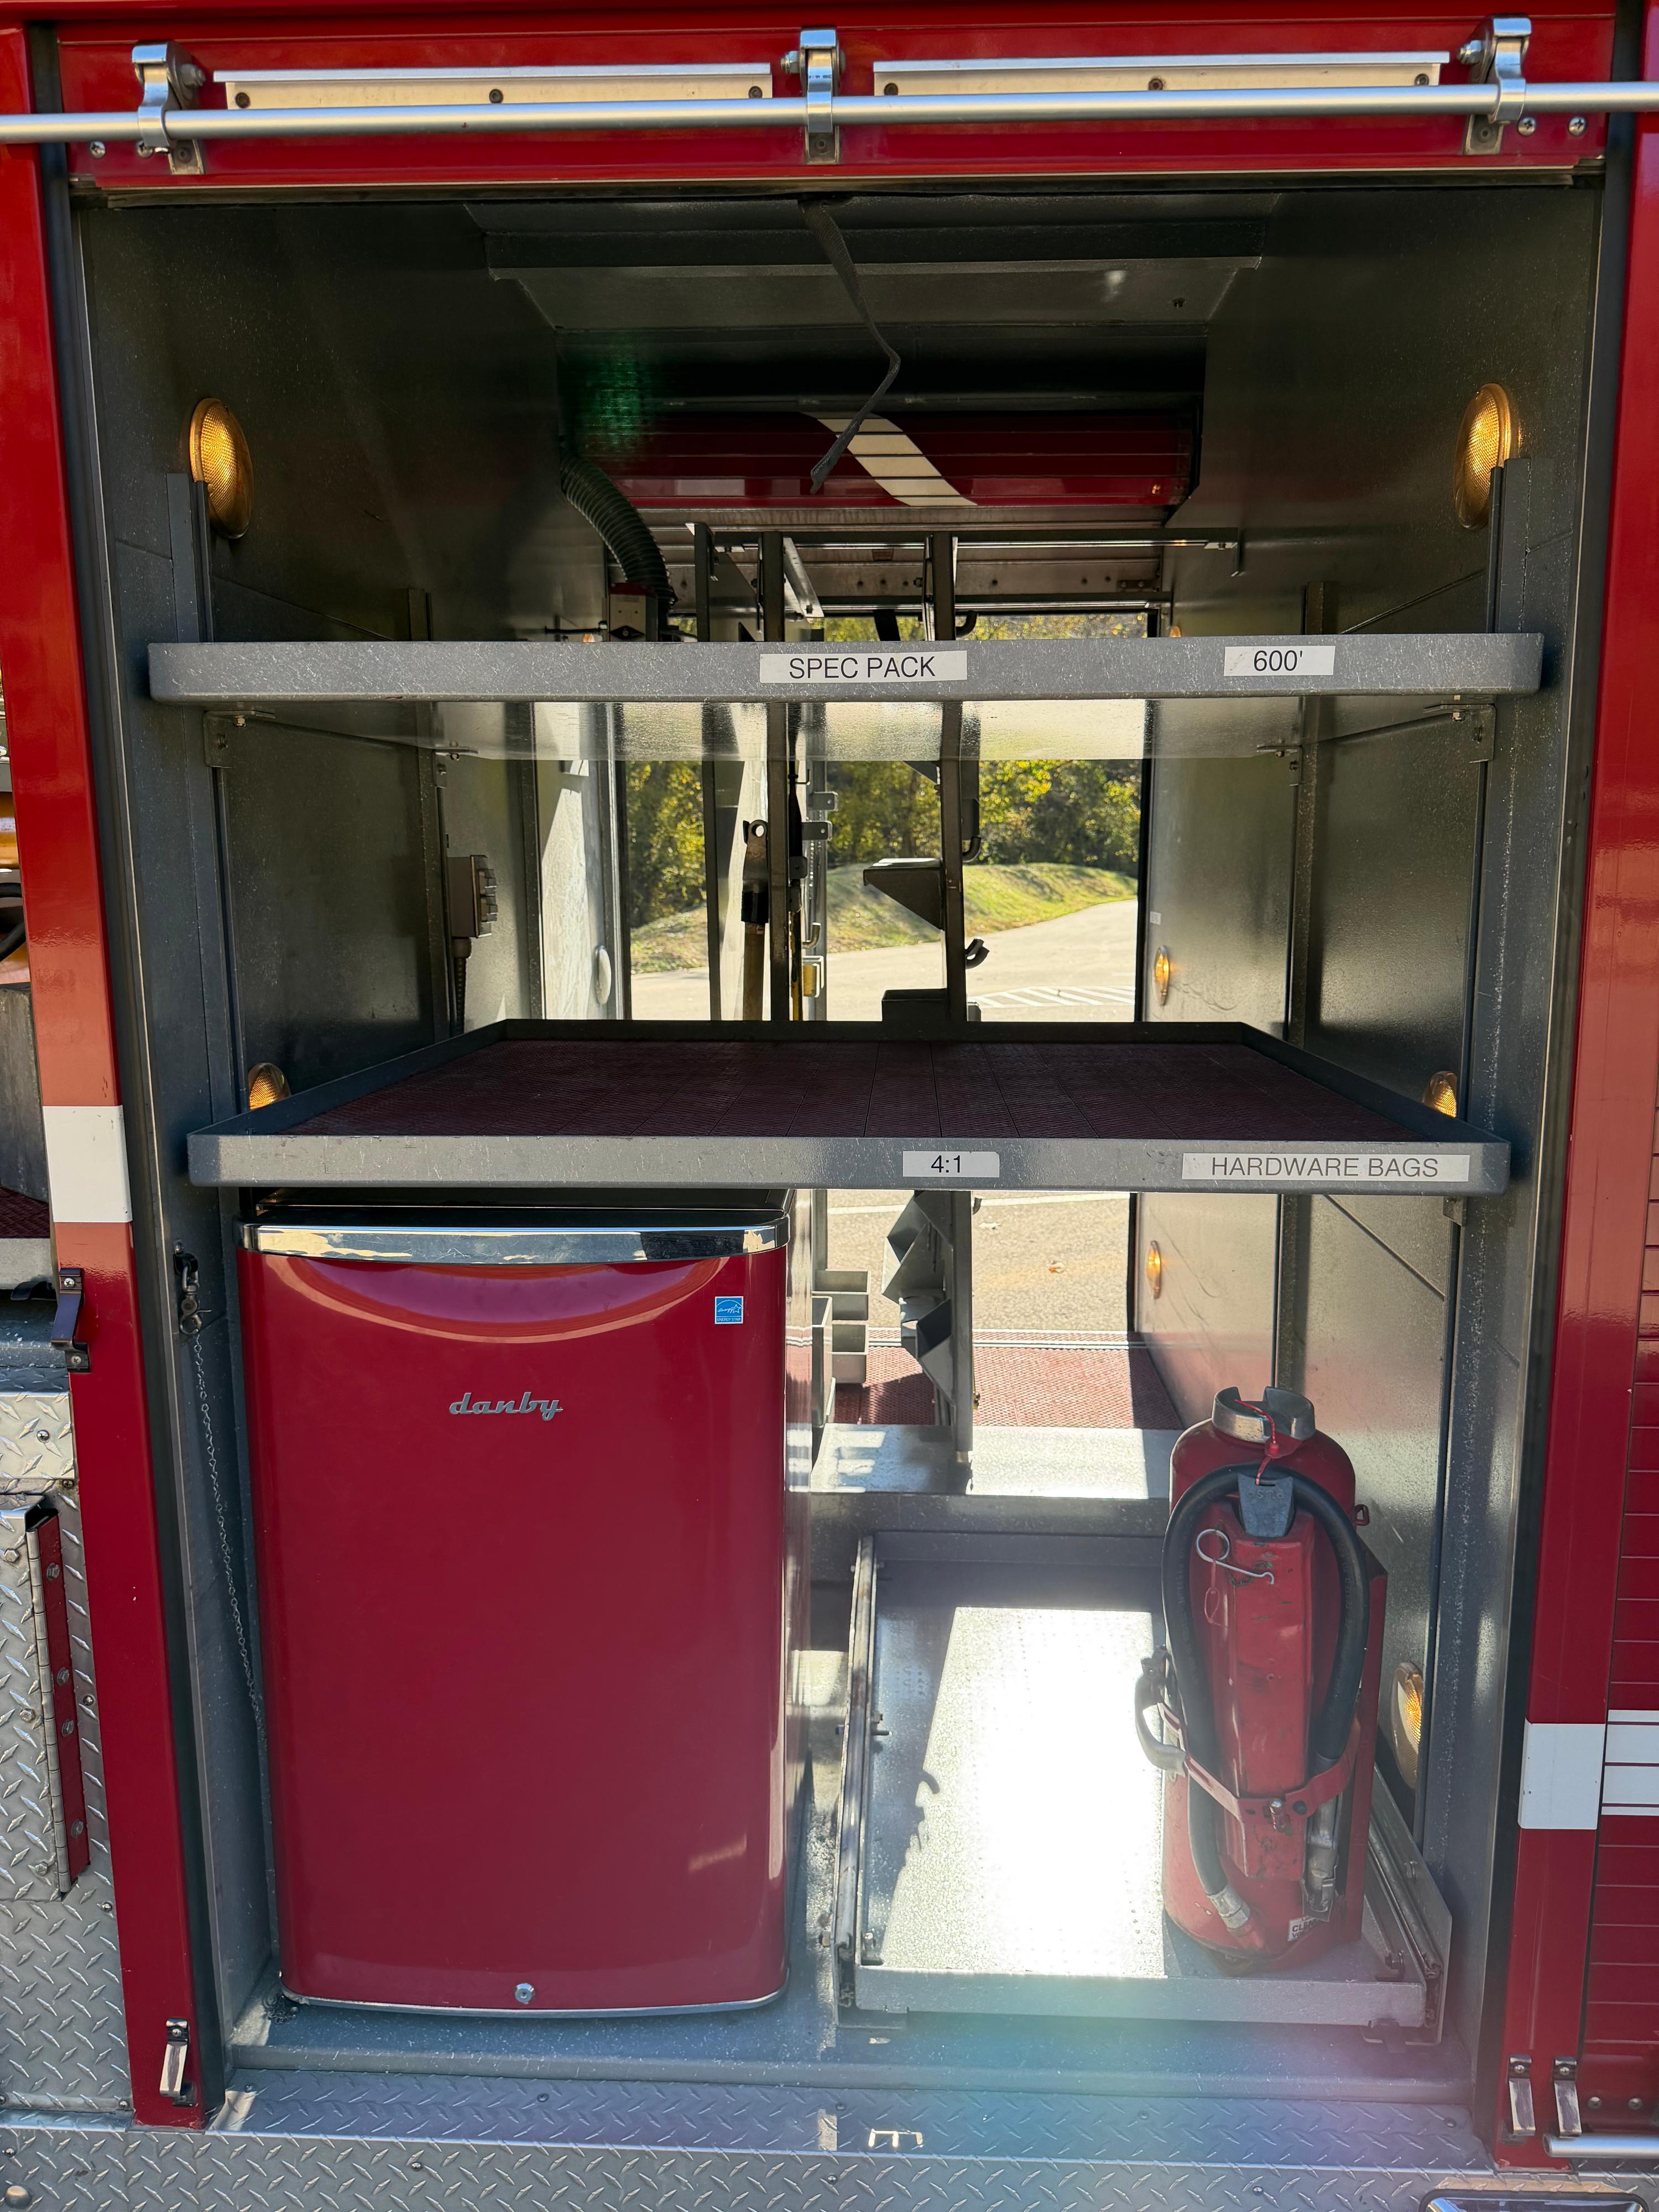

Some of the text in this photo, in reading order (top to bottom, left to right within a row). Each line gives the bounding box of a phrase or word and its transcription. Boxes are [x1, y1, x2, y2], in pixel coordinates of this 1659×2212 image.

[789, 656, 936, 679] SPEC PACK
[1254, 650, 1303, 672] 600'
[930, 1155, 961, 1173] 4:1
[1212, 1157, 1439, 1178] HARDWARE BAGS
[449, 1391, 564, 1422] danby
